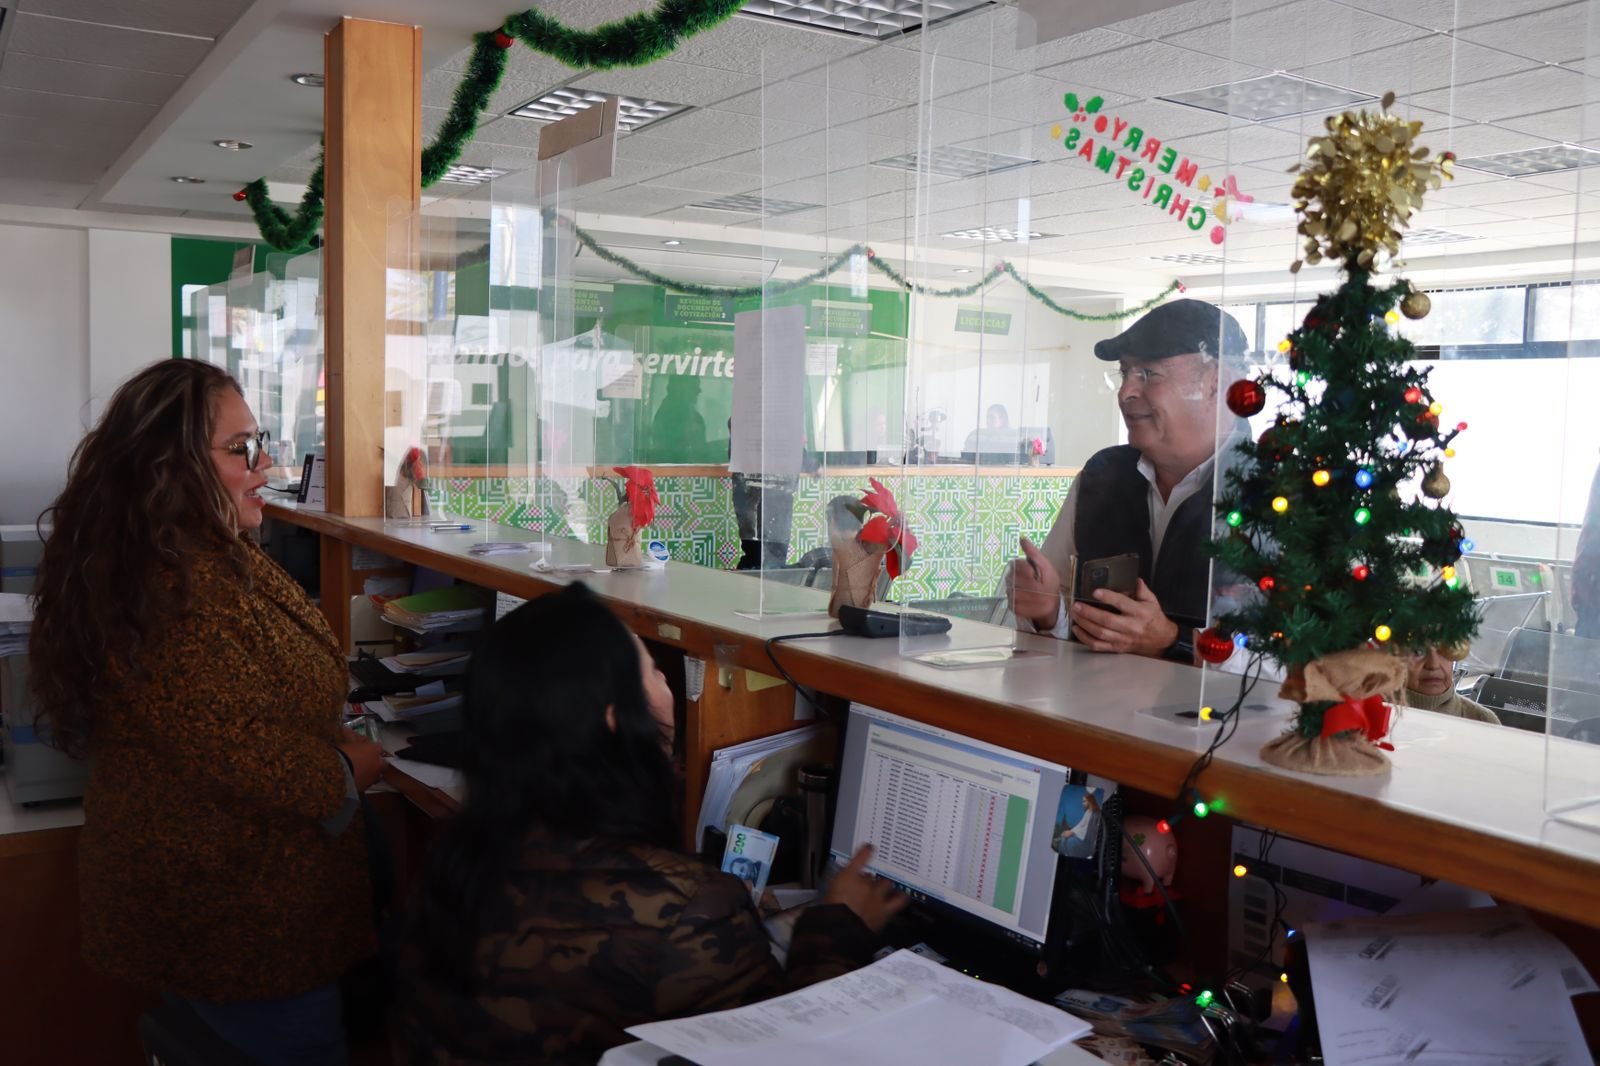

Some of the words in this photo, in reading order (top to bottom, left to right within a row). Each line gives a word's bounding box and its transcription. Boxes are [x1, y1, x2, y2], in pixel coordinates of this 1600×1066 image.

[677, 304, 723, 312] DOCUMENTOS
[632, 346, 735, 378] servirte
[733, 832, 746, 855] 500
